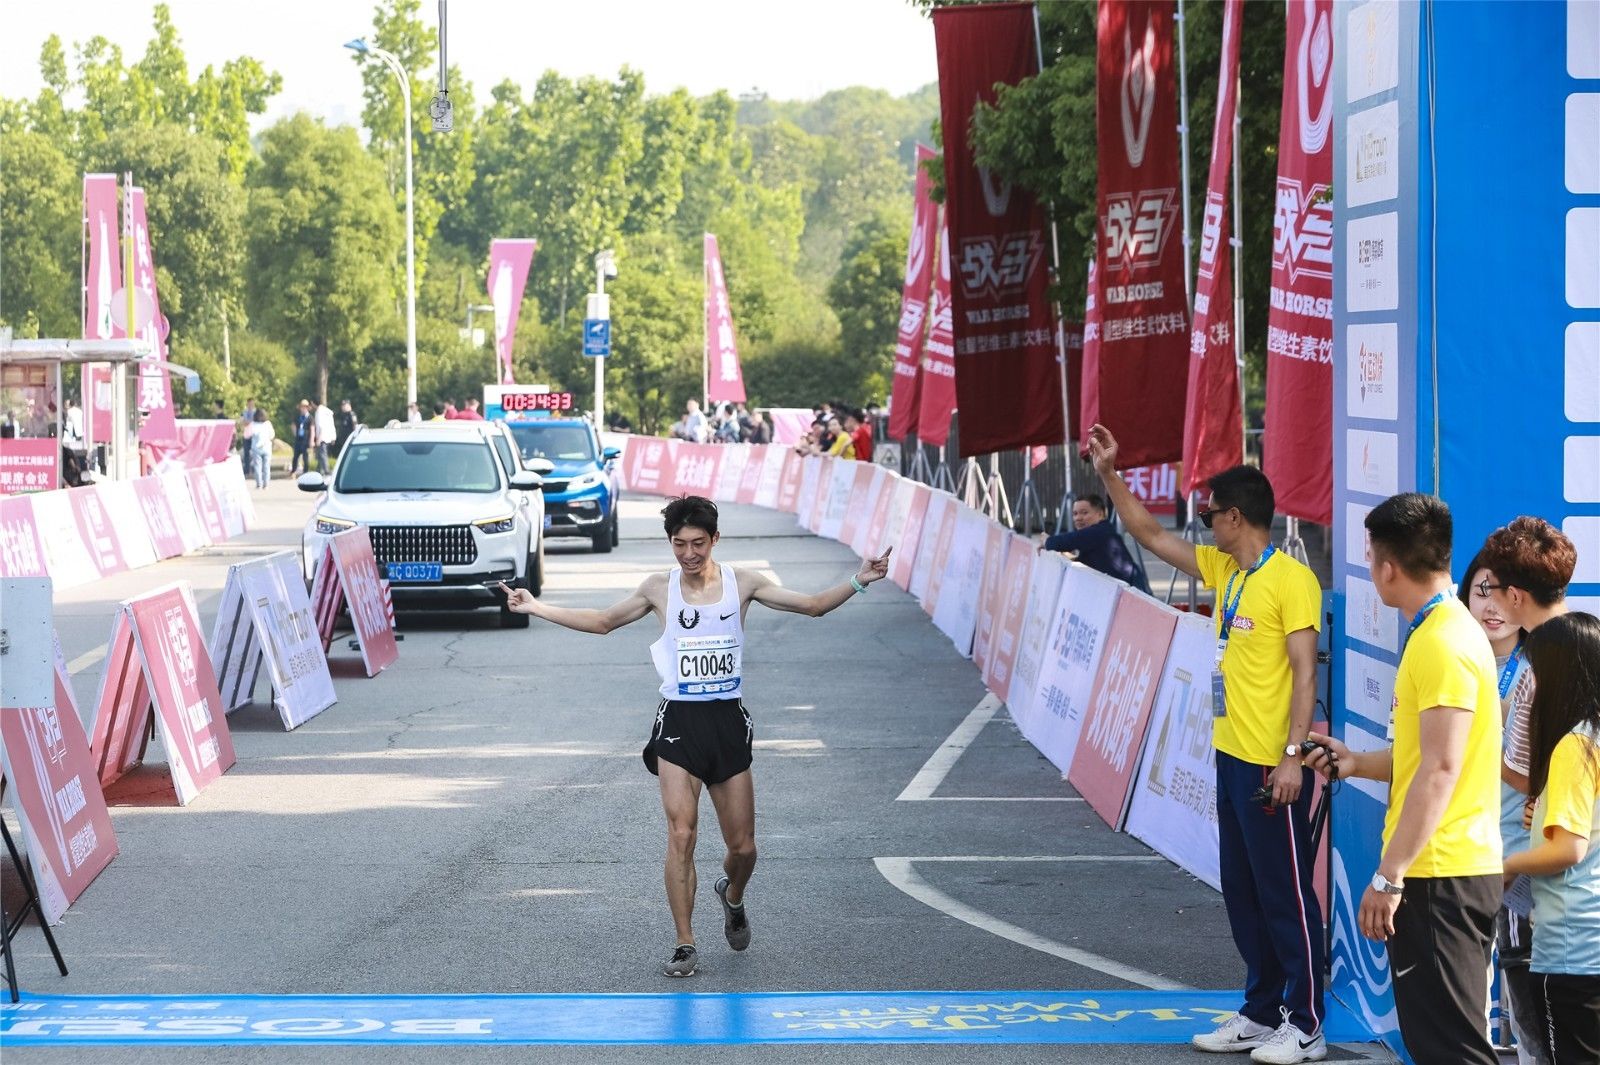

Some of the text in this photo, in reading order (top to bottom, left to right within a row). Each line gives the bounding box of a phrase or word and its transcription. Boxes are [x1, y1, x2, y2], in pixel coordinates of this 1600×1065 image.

[1106, 200, 1166, 260] 战马
[960, 239, 1031, 289] 战马
[503, 392, 572, 410] 00:34:33
[680, 653, 733, 678] C10043
[1086, 642, 1152, 774] 农夫山泉
